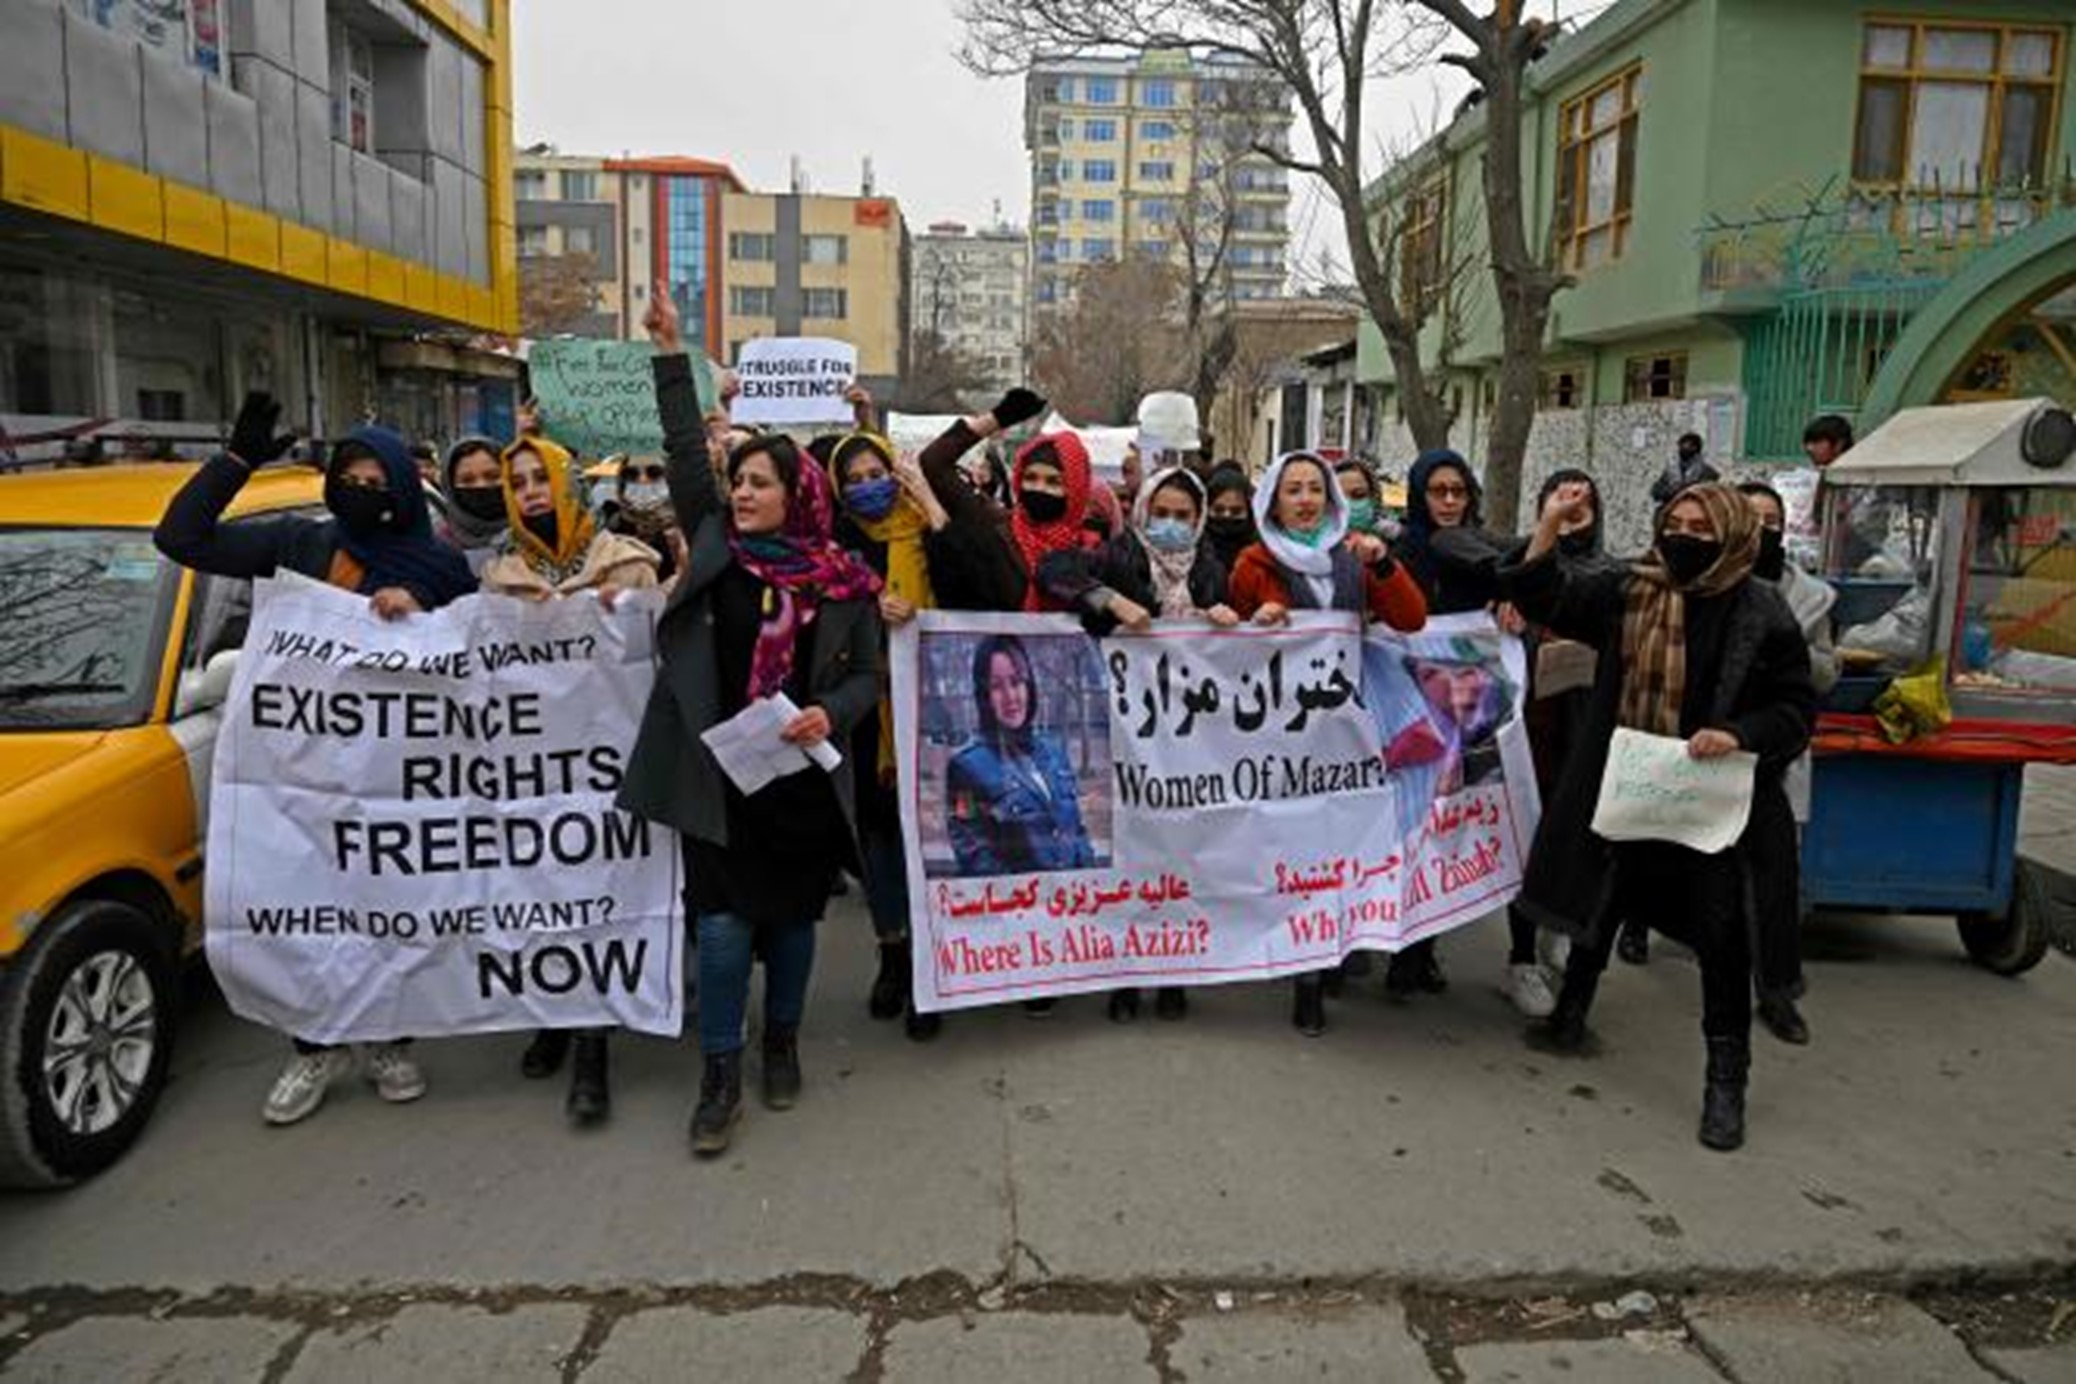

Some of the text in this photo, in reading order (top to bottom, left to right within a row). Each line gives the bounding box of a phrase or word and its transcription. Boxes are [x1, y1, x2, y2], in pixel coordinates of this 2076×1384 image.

[821, 359, 852, 375] FOR
[266, 630, 596, 679] WHAT DO WE WANT?
[252, 683, 542, 741] EXISTENCE
[1109, 649, 1366, 738] ختران مزار؟
[402, 745, 623, 801] RIGHTS
[1114, 754, 1386, 808] Women Of Mazar?
[333, 811, 651, 876] FREEDOM
[246, 895, 615, 938] WHEN DO WE WANT?
[1027, 930, 1055, 968] Is
[1061, 922, 1116, 963] Alia
[1122, 916, 1210, 957] Azizi?
[1287, 905, 1337, 945] Wh
[476, 938, 648, 998] NOW
